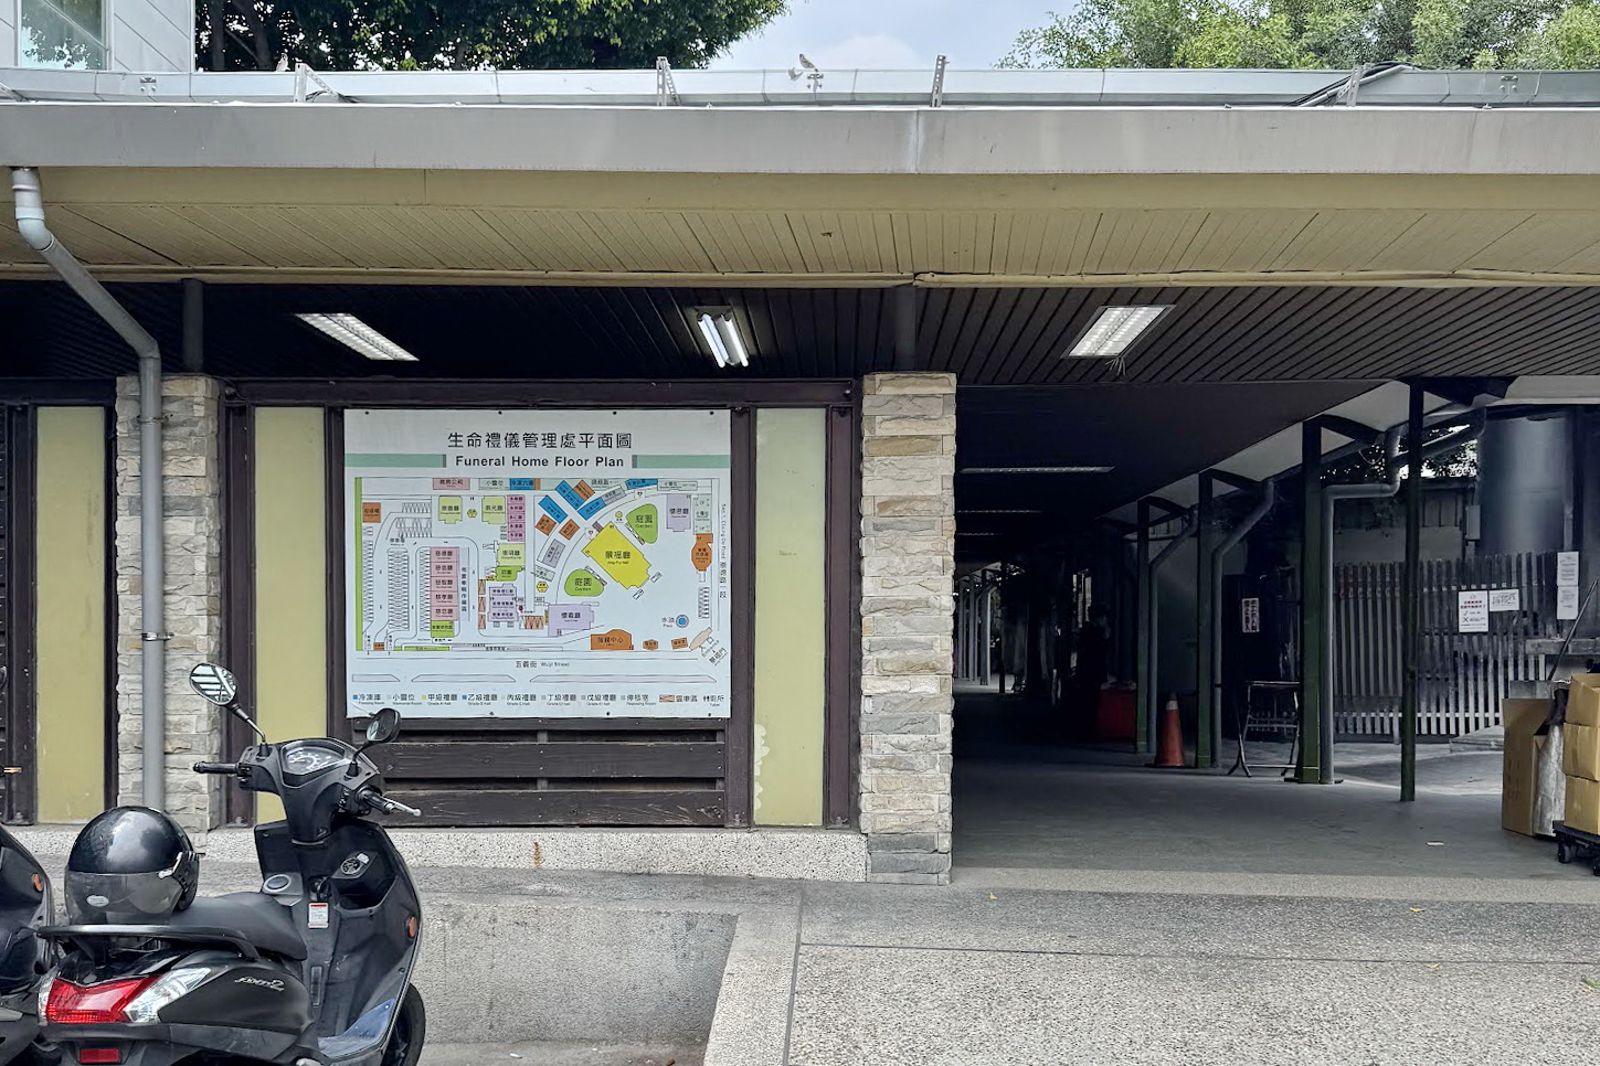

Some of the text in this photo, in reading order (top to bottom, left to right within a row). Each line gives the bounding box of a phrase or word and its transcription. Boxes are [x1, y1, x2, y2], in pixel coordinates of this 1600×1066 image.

[448, 432, 632, 449] 生命禮儀管理處平面圖
[455, 456, 624, 467] Funeral Home Floor Plan
[574, 578, 592, 587] 庭園
[427, 693, 458, 701] 甲級禮廳
[467, 693, 498, 701] 乙級禮廳
[506, 693, 537, 701] 丙級禮廳
[547, 694, 577, 702] 丁級禮廳
